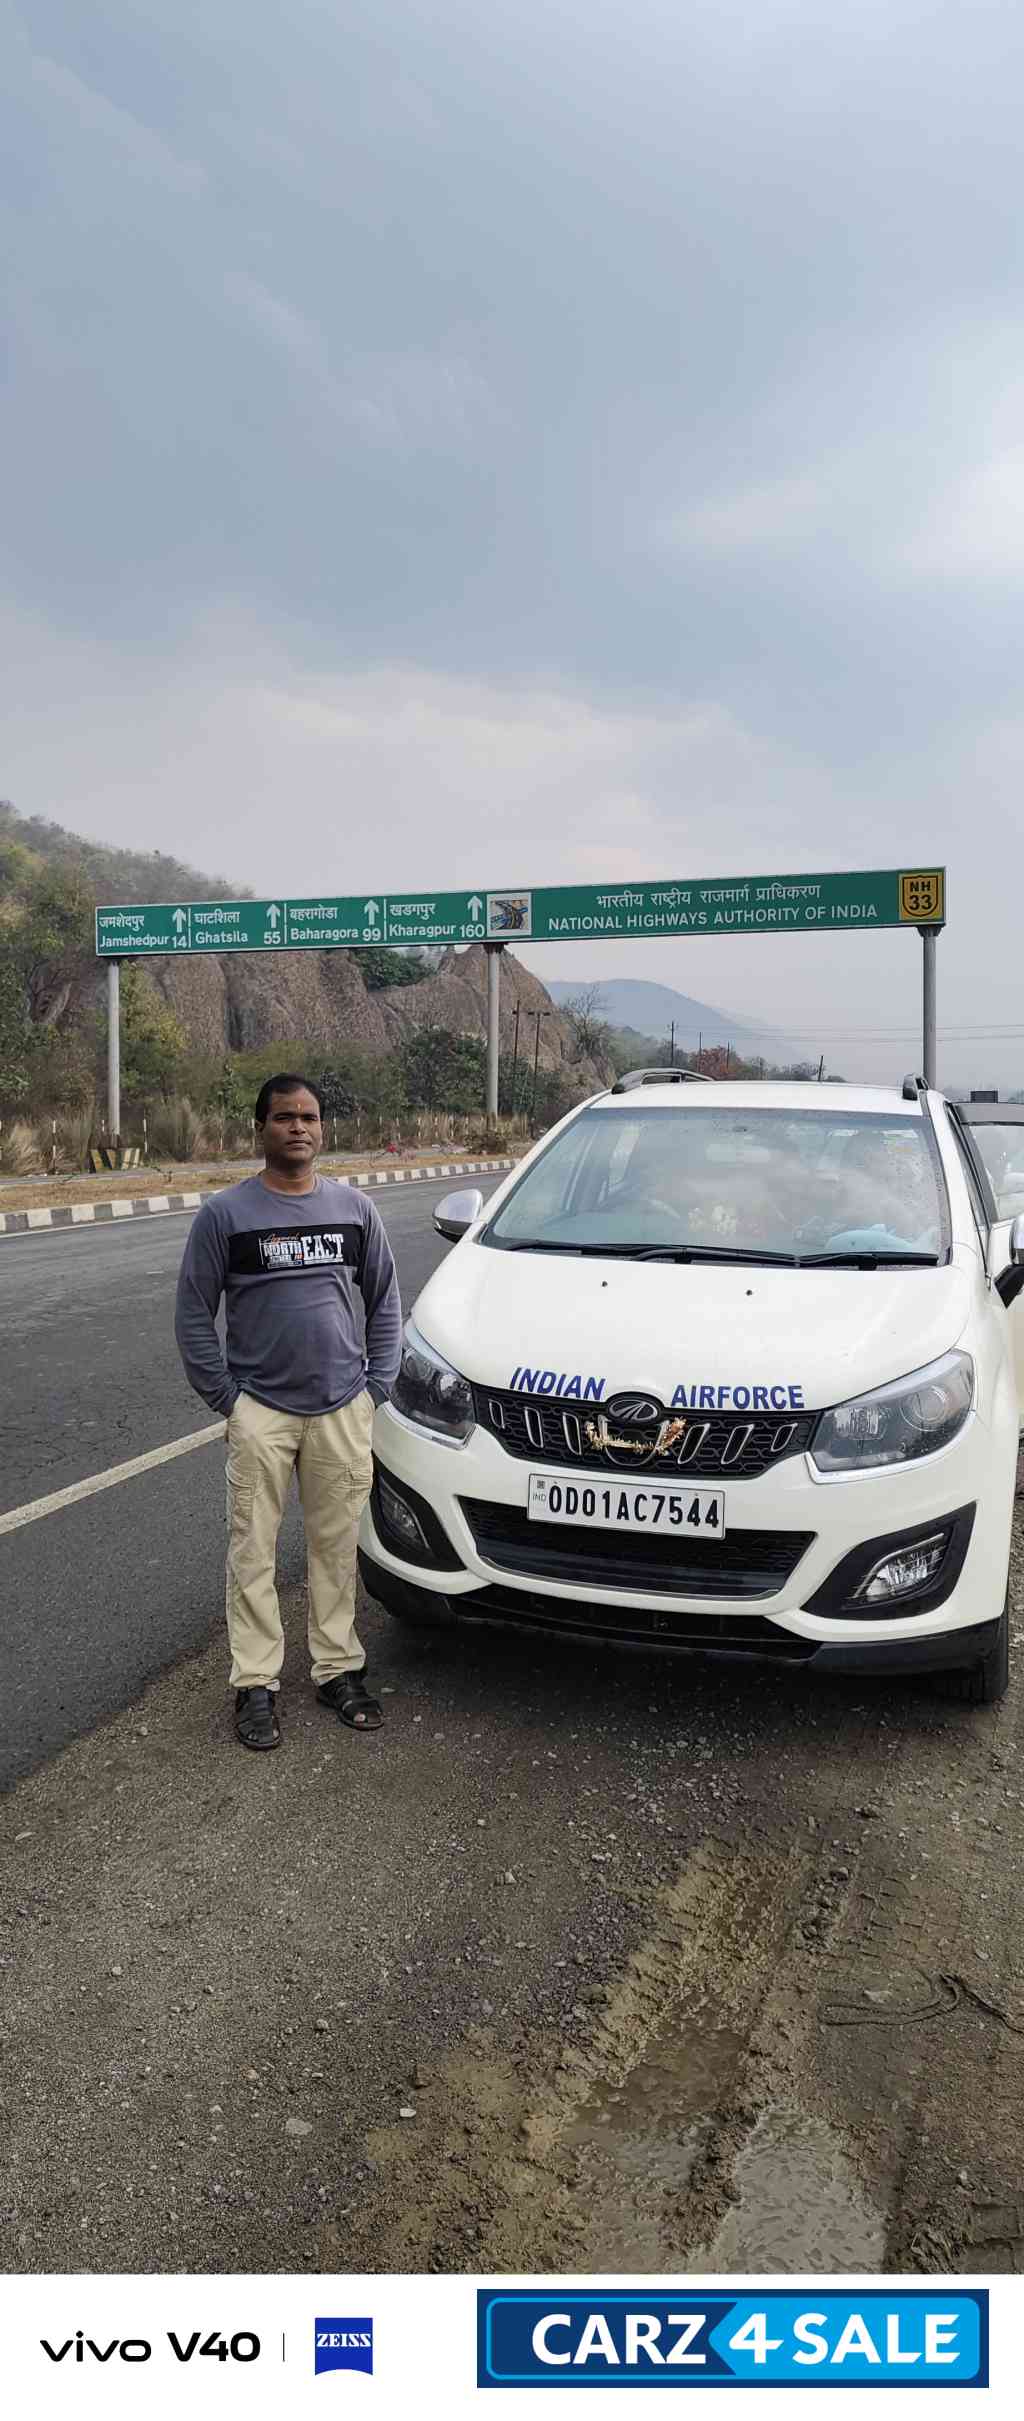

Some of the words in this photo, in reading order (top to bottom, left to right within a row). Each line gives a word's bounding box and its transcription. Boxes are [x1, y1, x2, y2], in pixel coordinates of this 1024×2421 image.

[596, 890, 644, 908] भारतीय
[650, 887, 692, 909] राष्ट्रीय
[700, 884, 749, 903] राजमार्ग
[756, 882, 821, 900] प्राधिकरण
[909, 881, 931, 893] NH
[909, 894, 932, 910] 33
[99, 912, 145, 931] जमशेदपुर
[194, 909, 240, 925] घाटशिला
[548, 916, 622, 931] NATIONAL
[627, 911, 707, 928] HIGHWAYS
[714, 907, 800, 924] AUTHORITY
[805, 906, 826, 920] OF
[831, 904, 878, 918] INDIA
[195, 931, 248, 945] Ghatsila
[263, 931, 281, 945] 55
[290, 927, 359, 942] Baharagora
[362, 928, 381, 942] 99
[389, 923, 456, 938] Kharagpur
[459, 923, 485, 937] 160
[99, 935, 170, 949] Jamshedpur
[172, 936, 187, 948] 14
[301, 1233, 344, 1260] EAST
[509, 1366, 607, 1401] INDIAN
[670, 1384, 805, 1409] AIRFORCE
[548, 1484, 719, 1528] OD01AC7544
